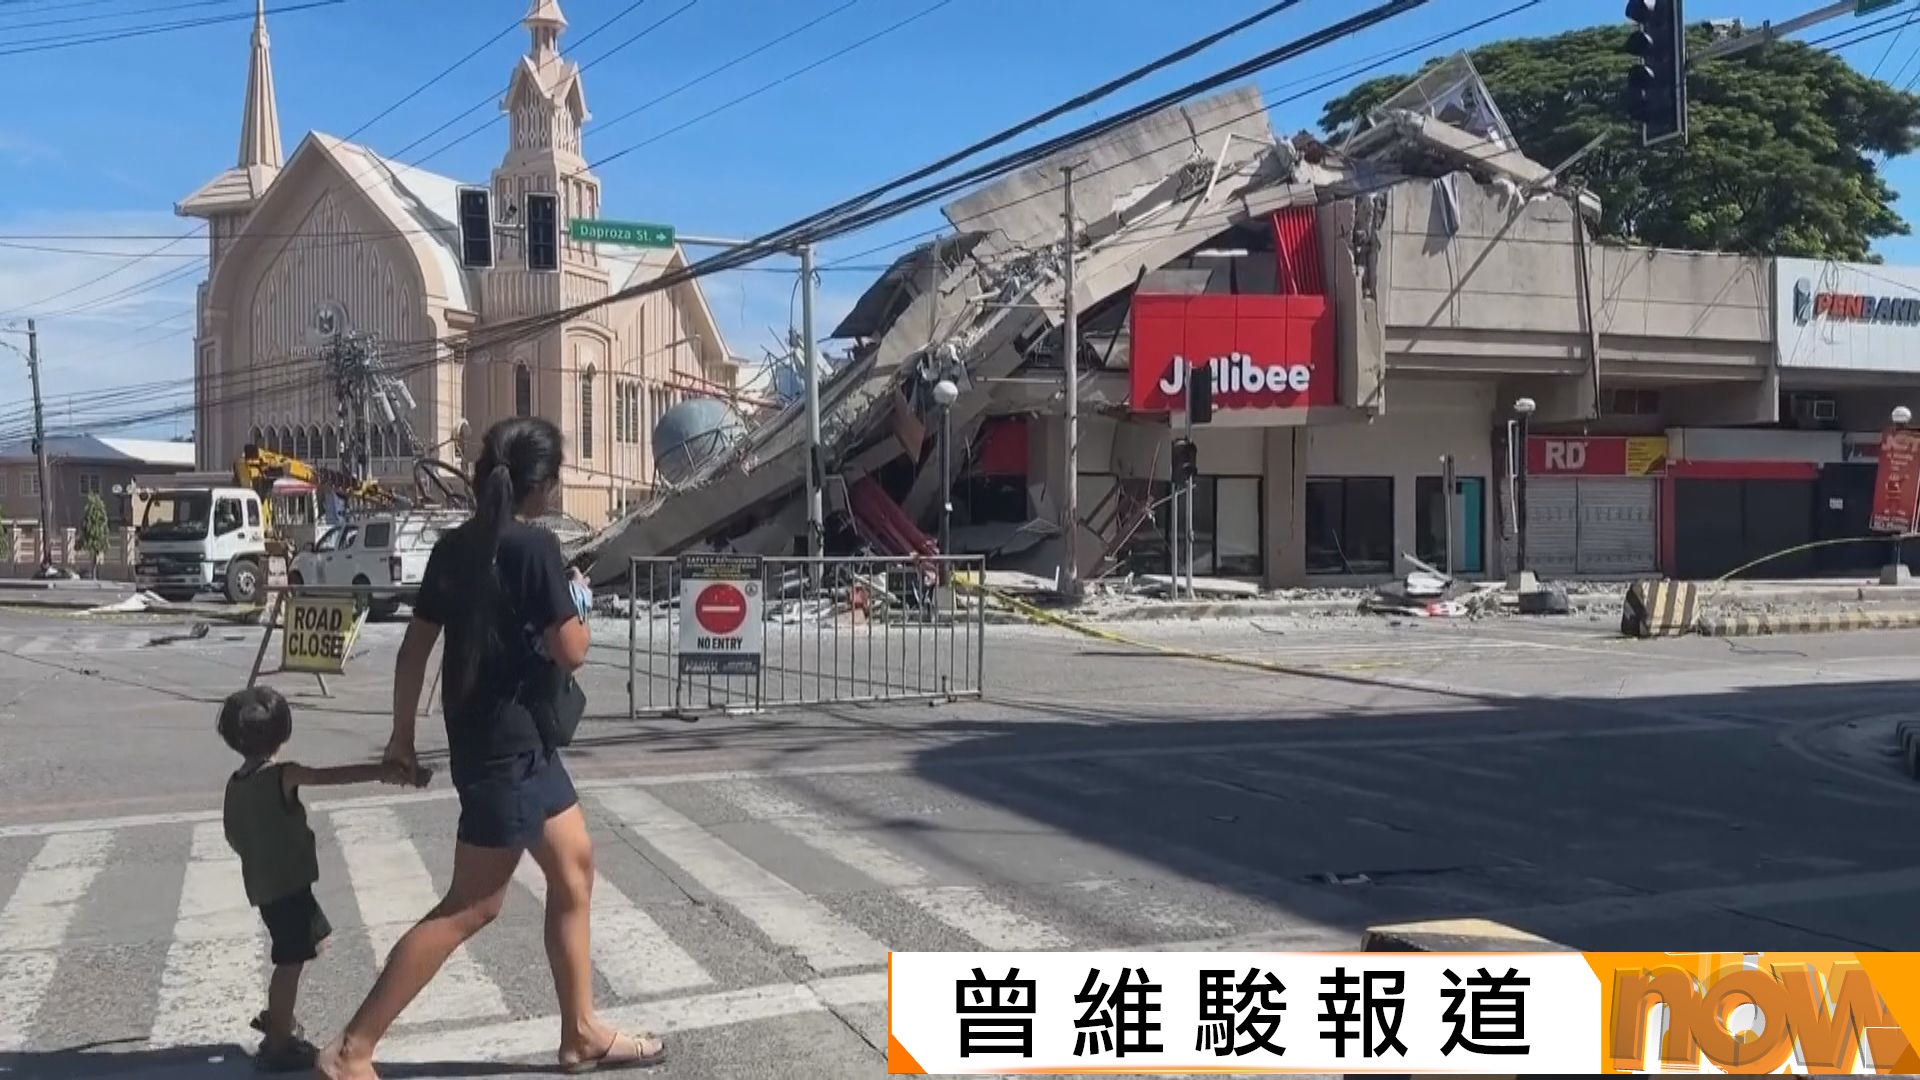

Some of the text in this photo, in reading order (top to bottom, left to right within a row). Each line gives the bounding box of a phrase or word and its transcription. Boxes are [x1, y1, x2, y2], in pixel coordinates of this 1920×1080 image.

[580, 224, 652, 241] Daproza St.
[1813, 293, 1920, 326] PENBANK
[1160, 352, 1311, 395] Jllibee
[1545, 440, 1586, 469] RD
[294, 606, 342, 632] ROAD
[288, 632, 346, 659] CLOSE
[697, 636, 743, 650] NO ENTRY
